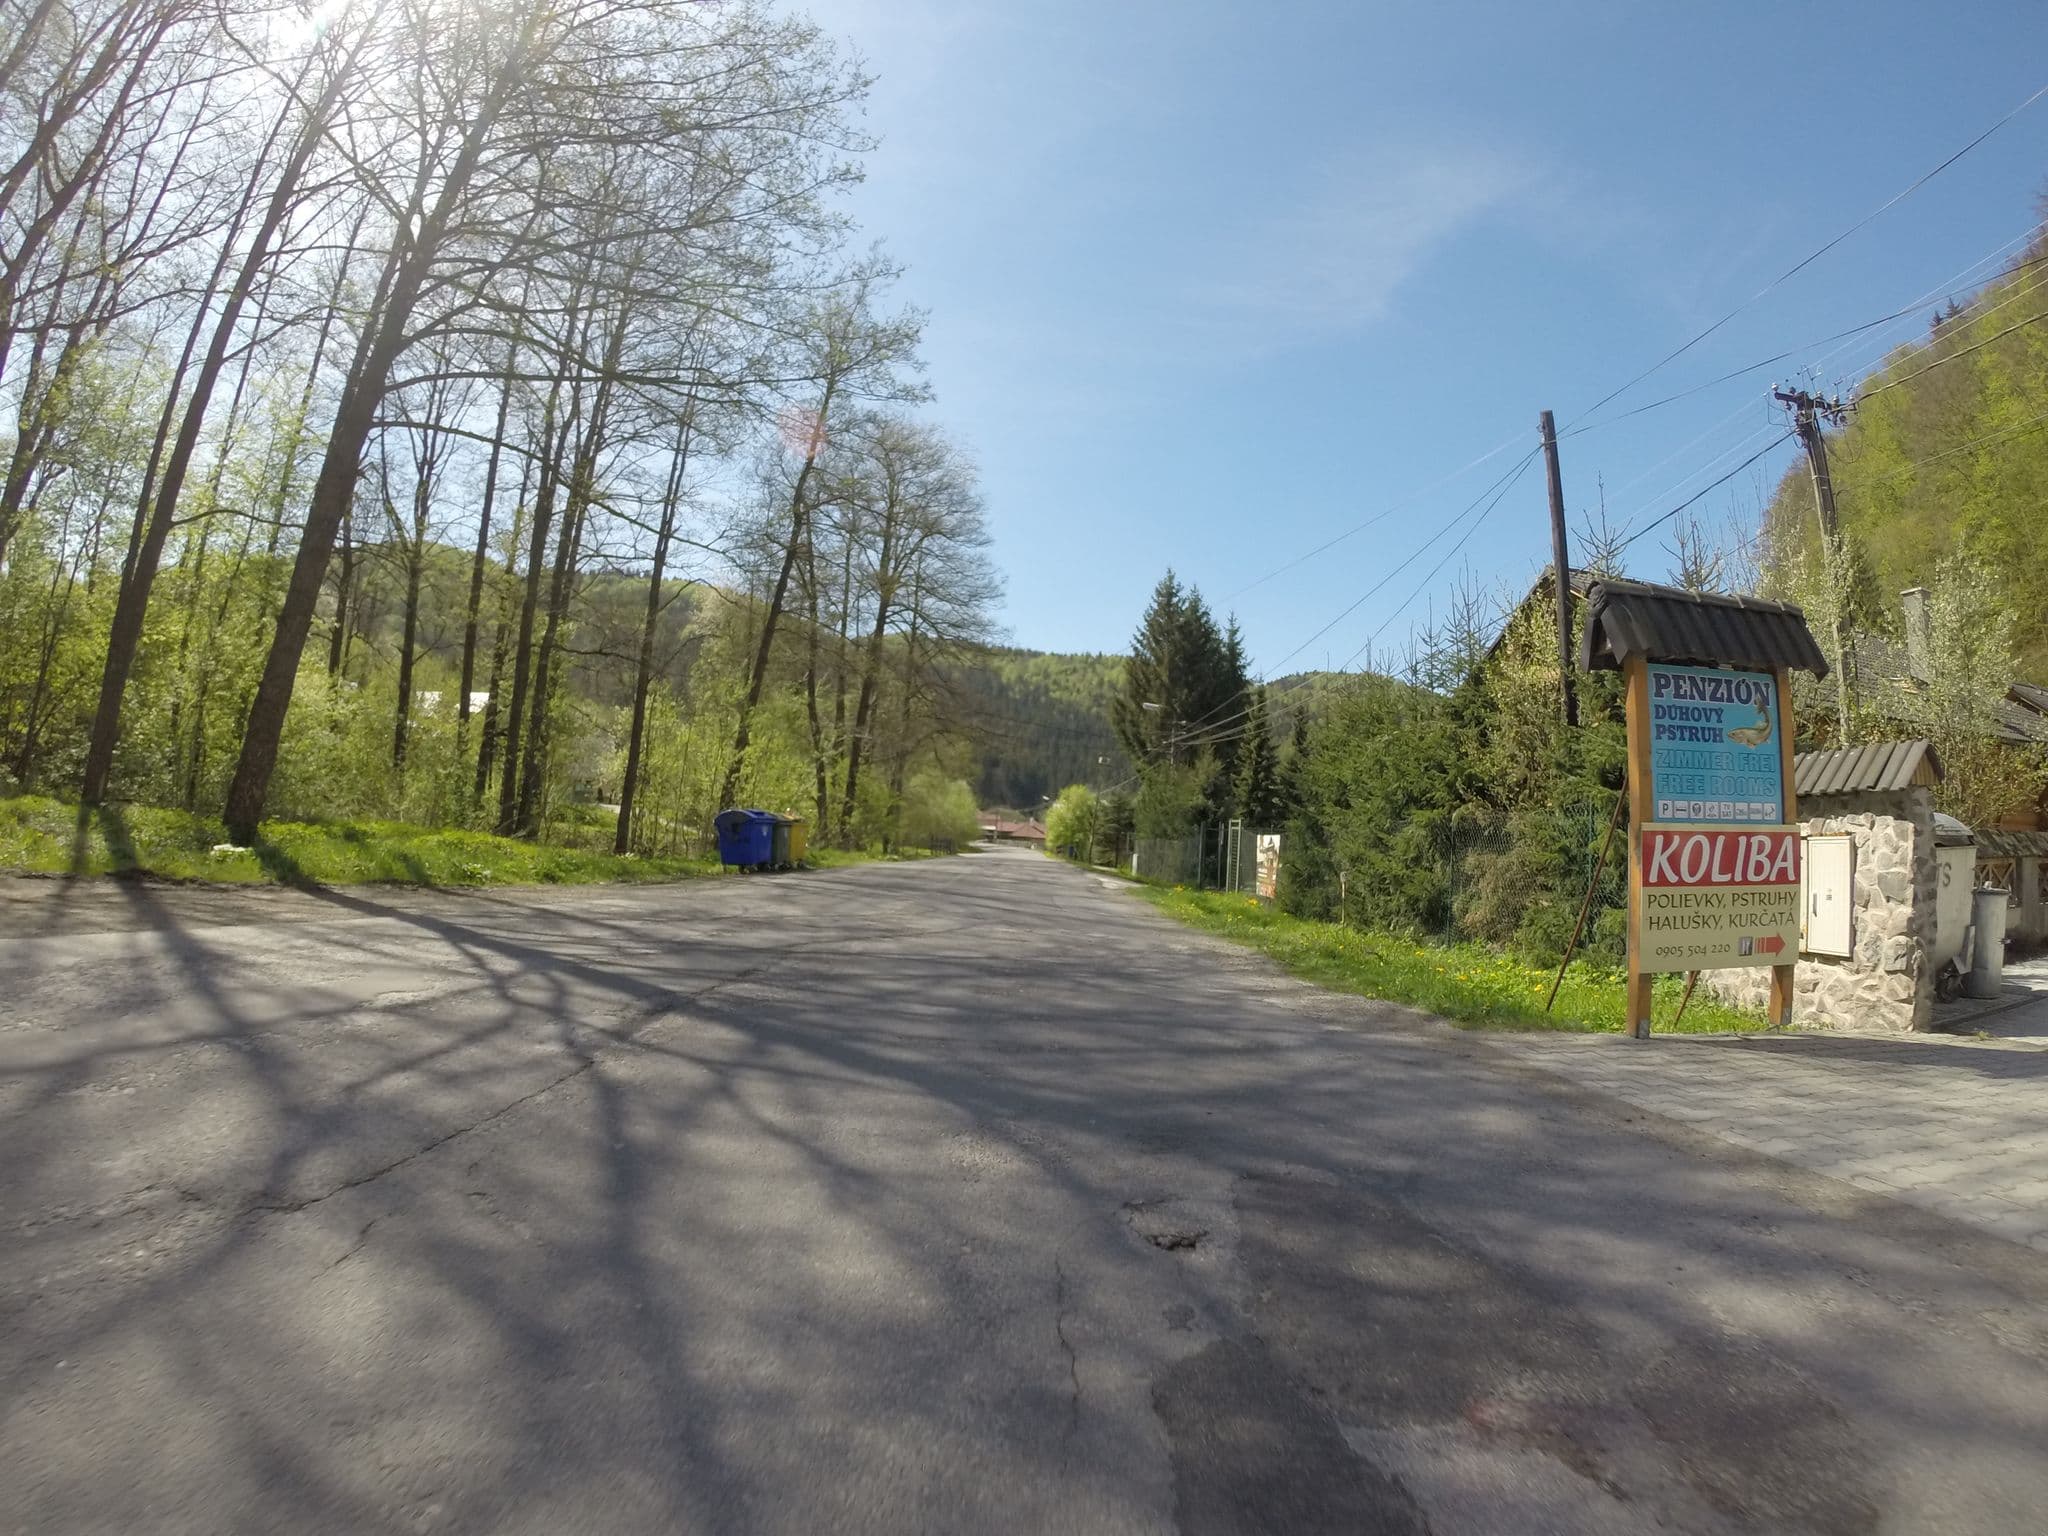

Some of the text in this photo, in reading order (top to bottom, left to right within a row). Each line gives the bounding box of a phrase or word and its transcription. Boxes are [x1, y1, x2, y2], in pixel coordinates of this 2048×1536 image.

[1653, 673, 1771, 706] PENZIÓN
[1655, 724, 1725, 743] PSTRUH
[1656, 749, 1776, 772] ZIMMER FREI
[1657, 773, 1776, 796] FREE ROOMS
[1649, 835, 1796, 883] KOLIBA
[1647, 891, 1798, 909] POLIEVKY, PSTRUHY
[1648, 908, 1795, 931] HALUŠKY, KURČATÁ
[1656, 943, 1731, 957] 0905 504 220
